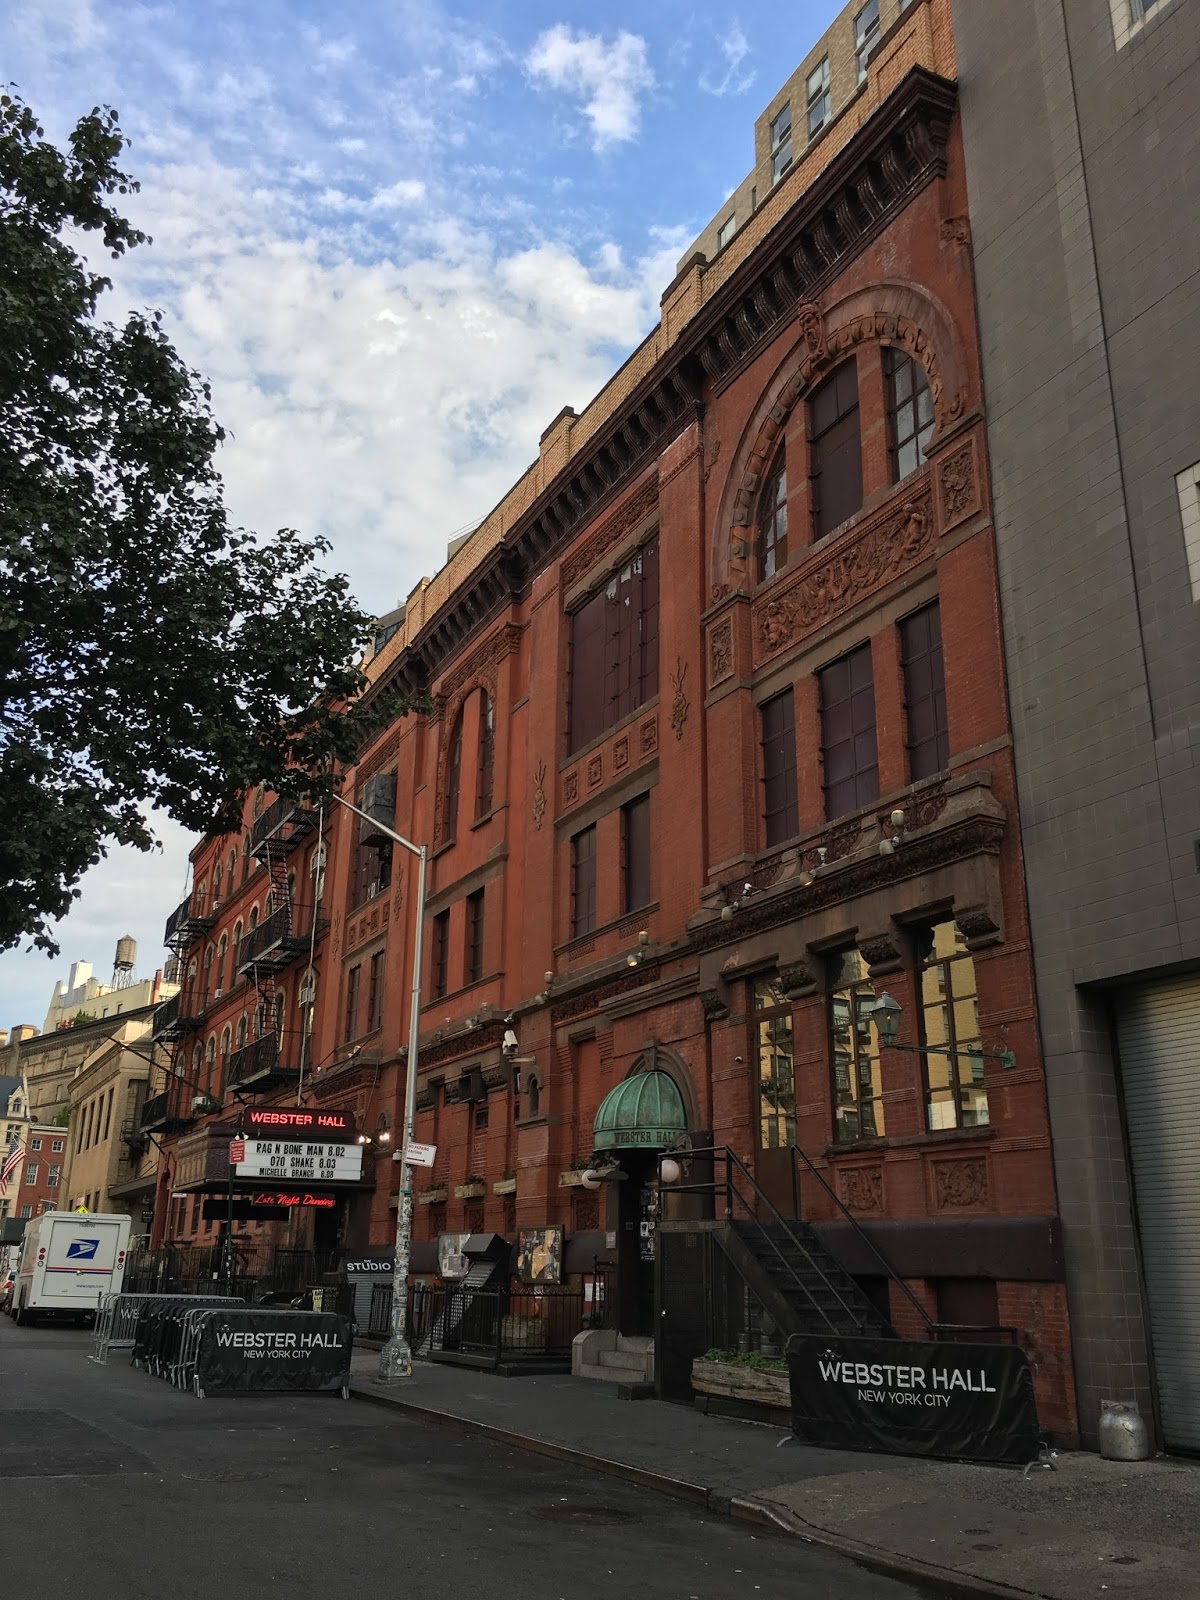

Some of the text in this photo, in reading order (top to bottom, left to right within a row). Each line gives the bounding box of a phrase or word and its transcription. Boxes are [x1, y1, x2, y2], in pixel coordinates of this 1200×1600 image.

[251, 1112, 346, 1127] WEBSTER HALL
[614, 1131, 651, 1143] WEBSTER
[256, 1143, 272, 1154] RAG
[275, 1144, 280, 1154] N
[284, 1144, 302, 1155] BONE
[307, 1145, 323, 1156] MAN
[328, 1146, 345, 1157] 8.02
[290, 1157, 314, 1168] SHAKE
[319, 1158, 336, 1169] 8.03
[259, 1167, 287, 1177] MICHELLE
[292, 1169, 314, 1178] BRANCH
[255, 1194, 334, 1207] Late Night Dancing
[347, 1262, 391, 1271] STUDIO
[216, 1332, 343, 1348] WEBSTER HALL
[243, 1350, 312, 1359] NEW YORK CITY
[818, 1360, 996, 1392] WEBSTER HALL
[858, 1389, 950, 1407] NEW YORK CITY
